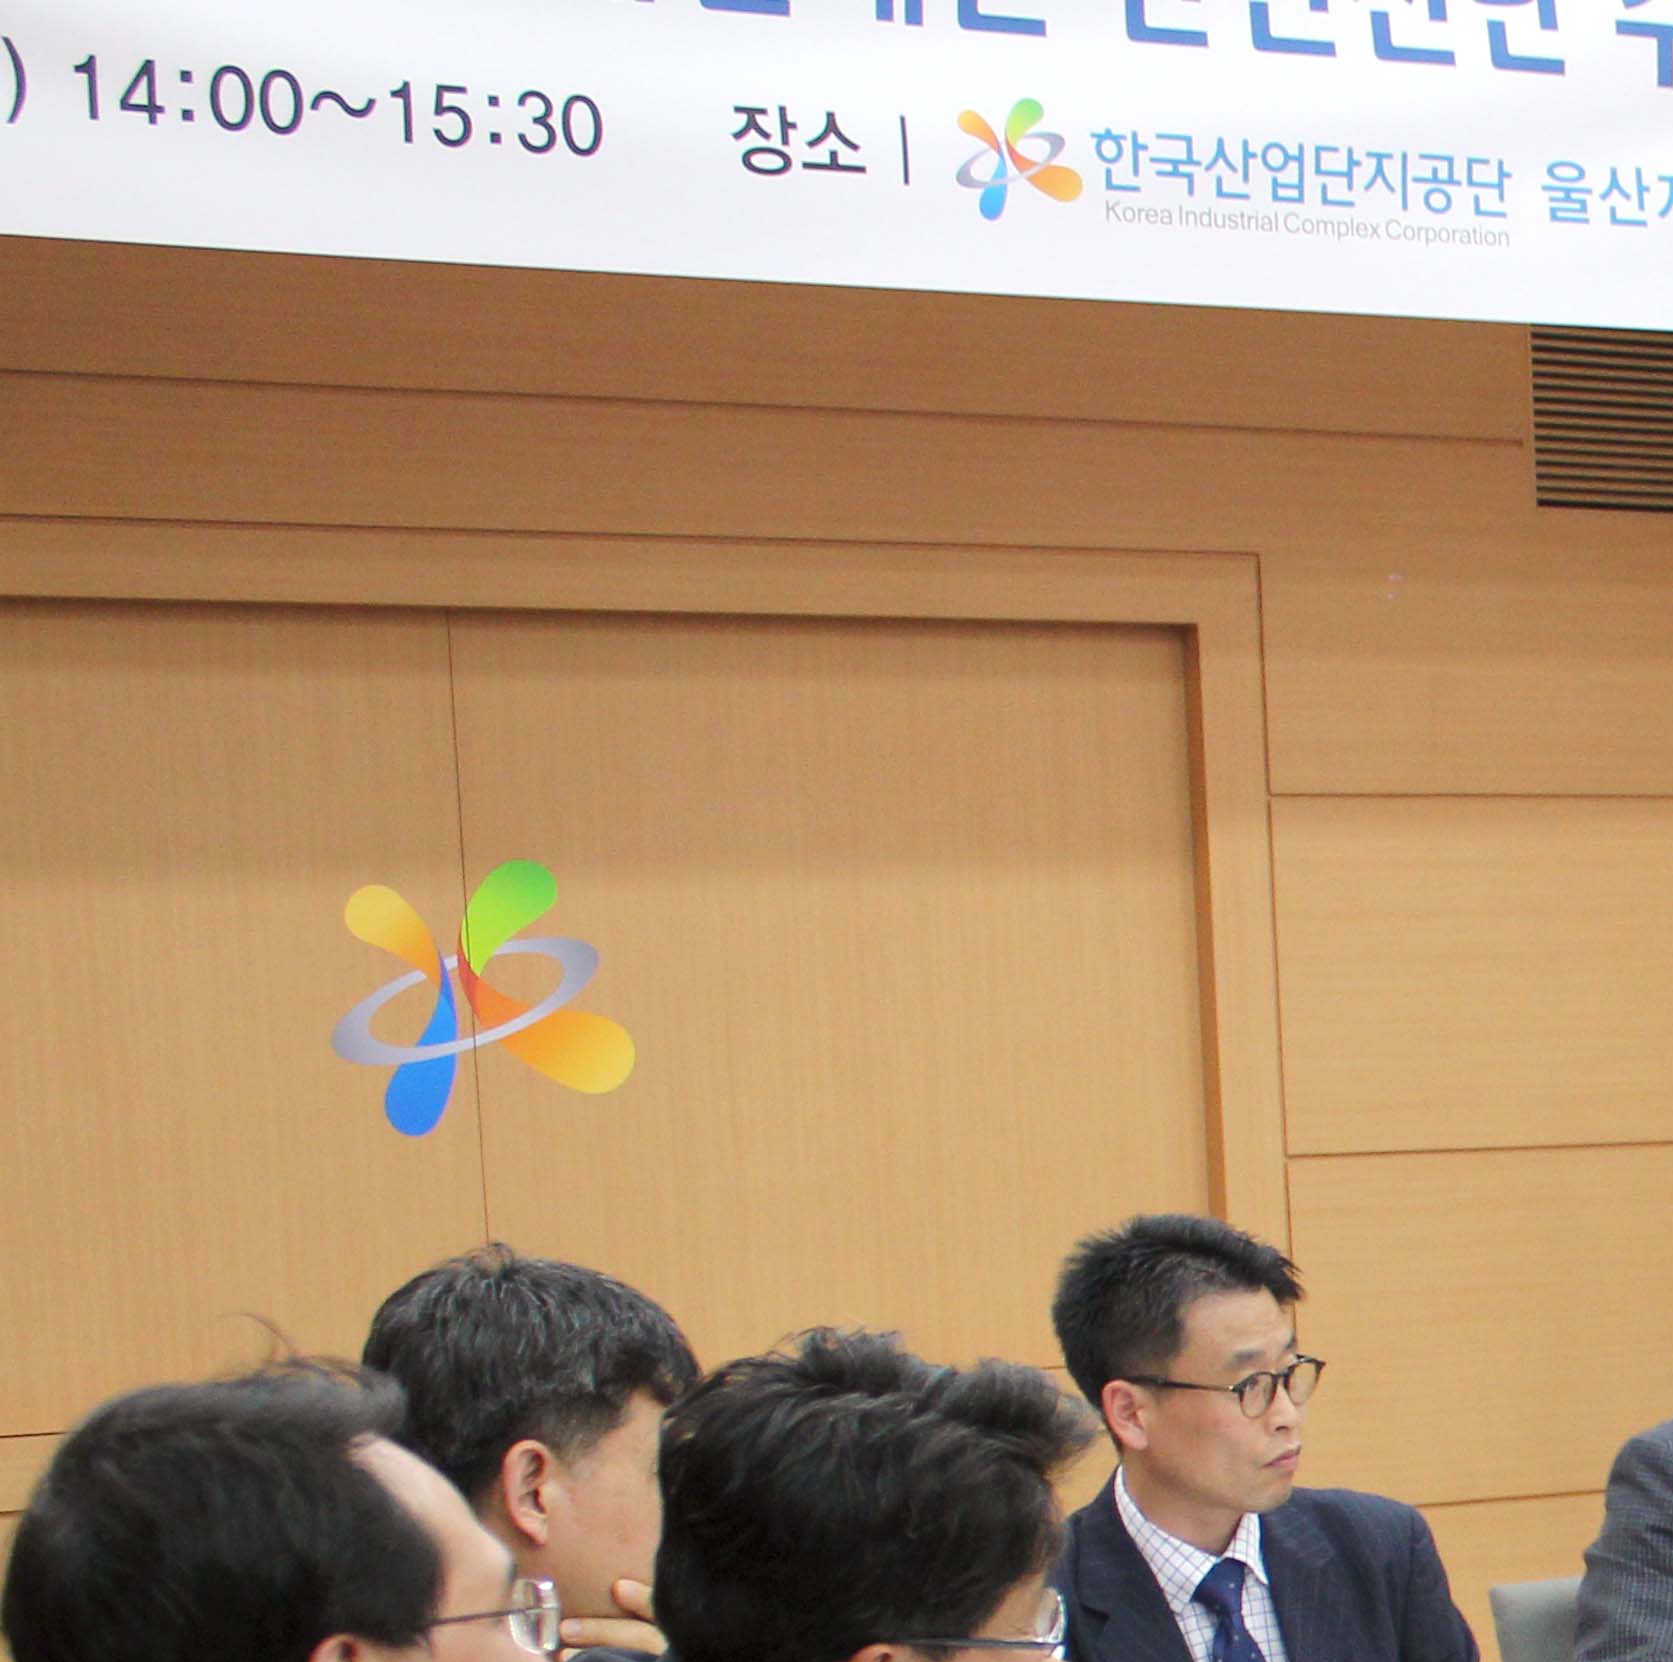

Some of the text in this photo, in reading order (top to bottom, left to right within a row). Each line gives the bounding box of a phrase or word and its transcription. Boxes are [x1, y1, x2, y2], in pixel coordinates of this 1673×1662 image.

[73, 53, 604, 158] 14:00~15:30
[731, 102, 868, 178] 장소
[1090, 127, 1513, 219] 한국산업단지공단
[1105, 200, 1511, 248] Korea Industrial Complex Corporation
